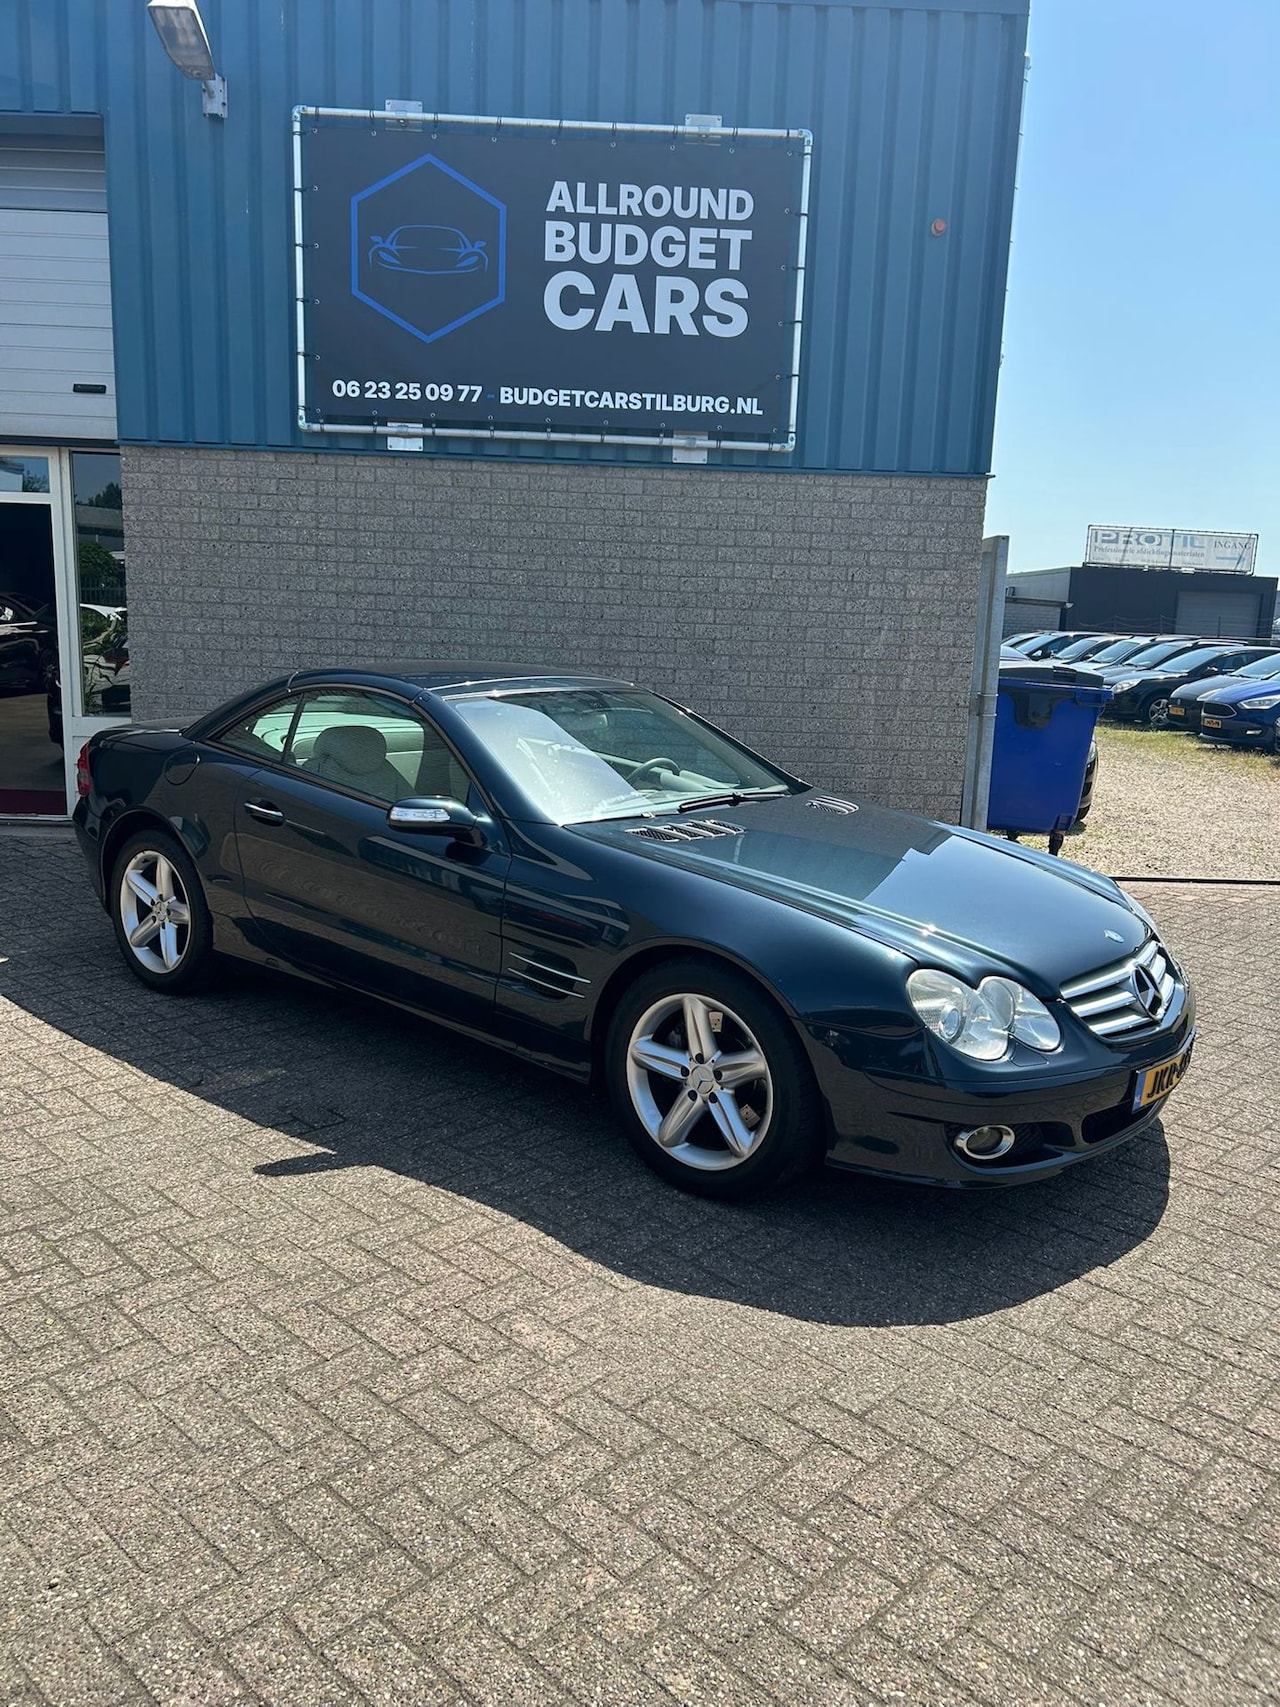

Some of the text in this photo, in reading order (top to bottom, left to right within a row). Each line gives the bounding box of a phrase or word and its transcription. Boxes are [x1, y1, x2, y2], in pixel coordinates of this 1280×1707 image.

[545, 180, 754, 221] ALLROUND
[544, 220, 753, 270] BUDGET
[543, 270, 750, 338] CARS
[332, 379, 361, 398] 06
[364, 380, 391, 400] 23
[395, 382, 422, 401] 25
[425, 383, 454, 402] 09
[457, 384, 483, 403] 77
[500, 386, 764, 415] BUDGETCARSTILBURG.NL
[1213, 539, 1252, 550] INGANG
